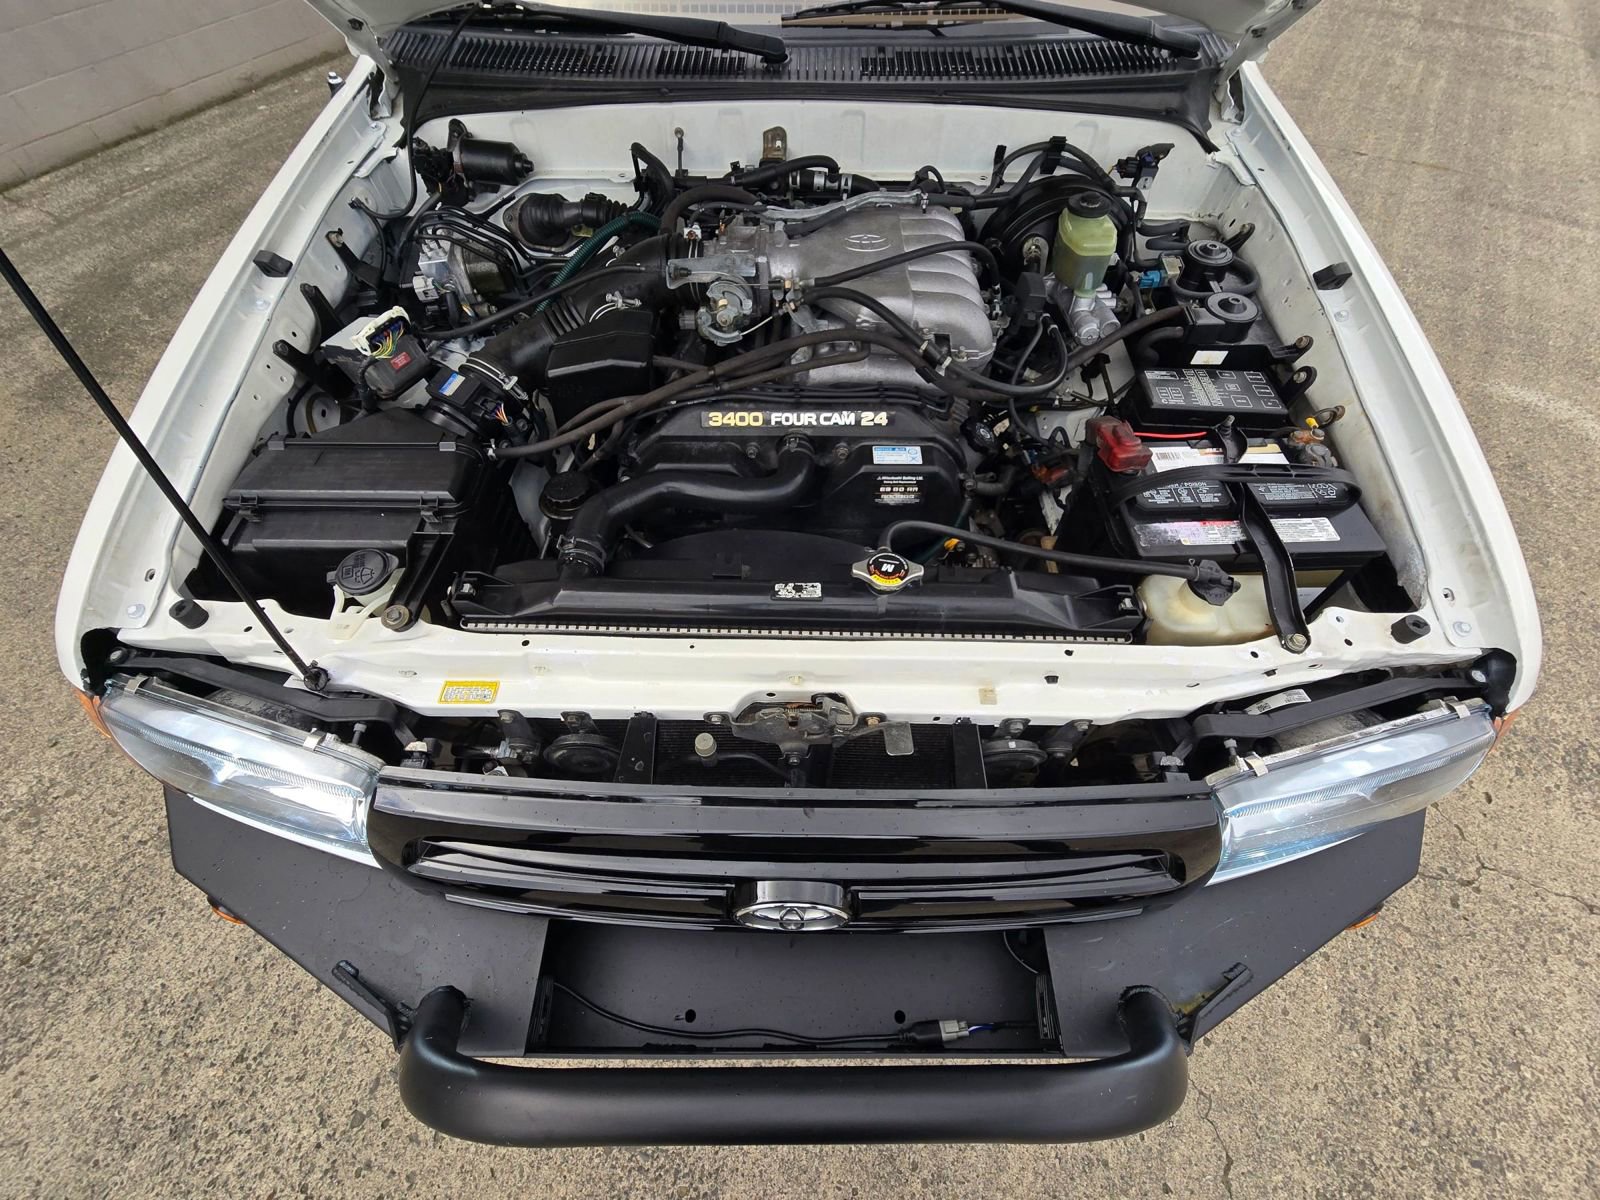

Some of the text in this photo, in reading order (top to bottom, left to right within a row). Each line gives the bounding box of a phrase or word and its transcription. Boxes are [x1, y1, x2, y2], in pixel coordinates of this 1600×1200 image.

[708, 411, 888, 427] 3400 FOUR CAM 24
